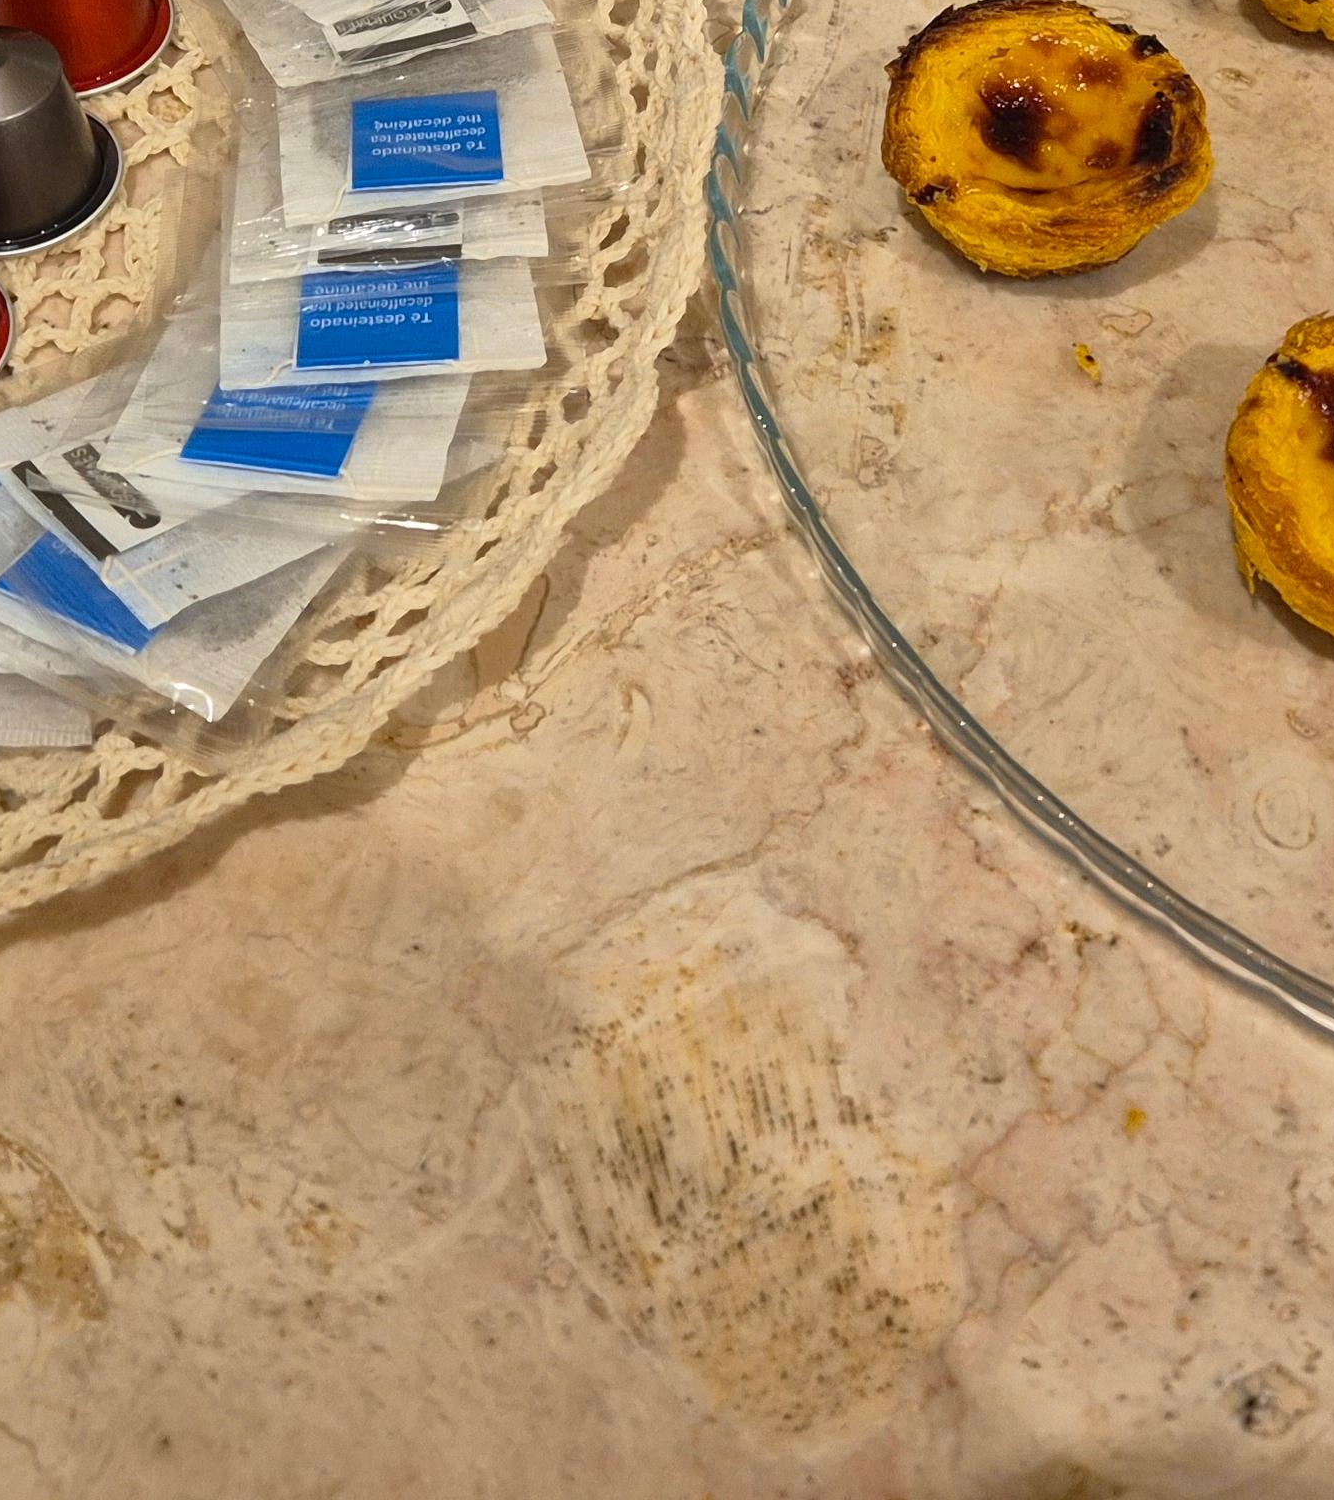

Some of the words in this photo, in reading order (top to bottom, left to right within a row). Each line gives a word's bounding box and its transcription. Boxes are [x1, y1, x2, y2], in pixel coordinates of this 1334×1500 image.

[371, 134, 391, 144] tea
[396, 127, 486, 142] decaffeinated
[372, 142, 461, 158] desteinado
[336, 296, 433, 312] decaffeinated
[310, 314, 406, 329] desteinado
